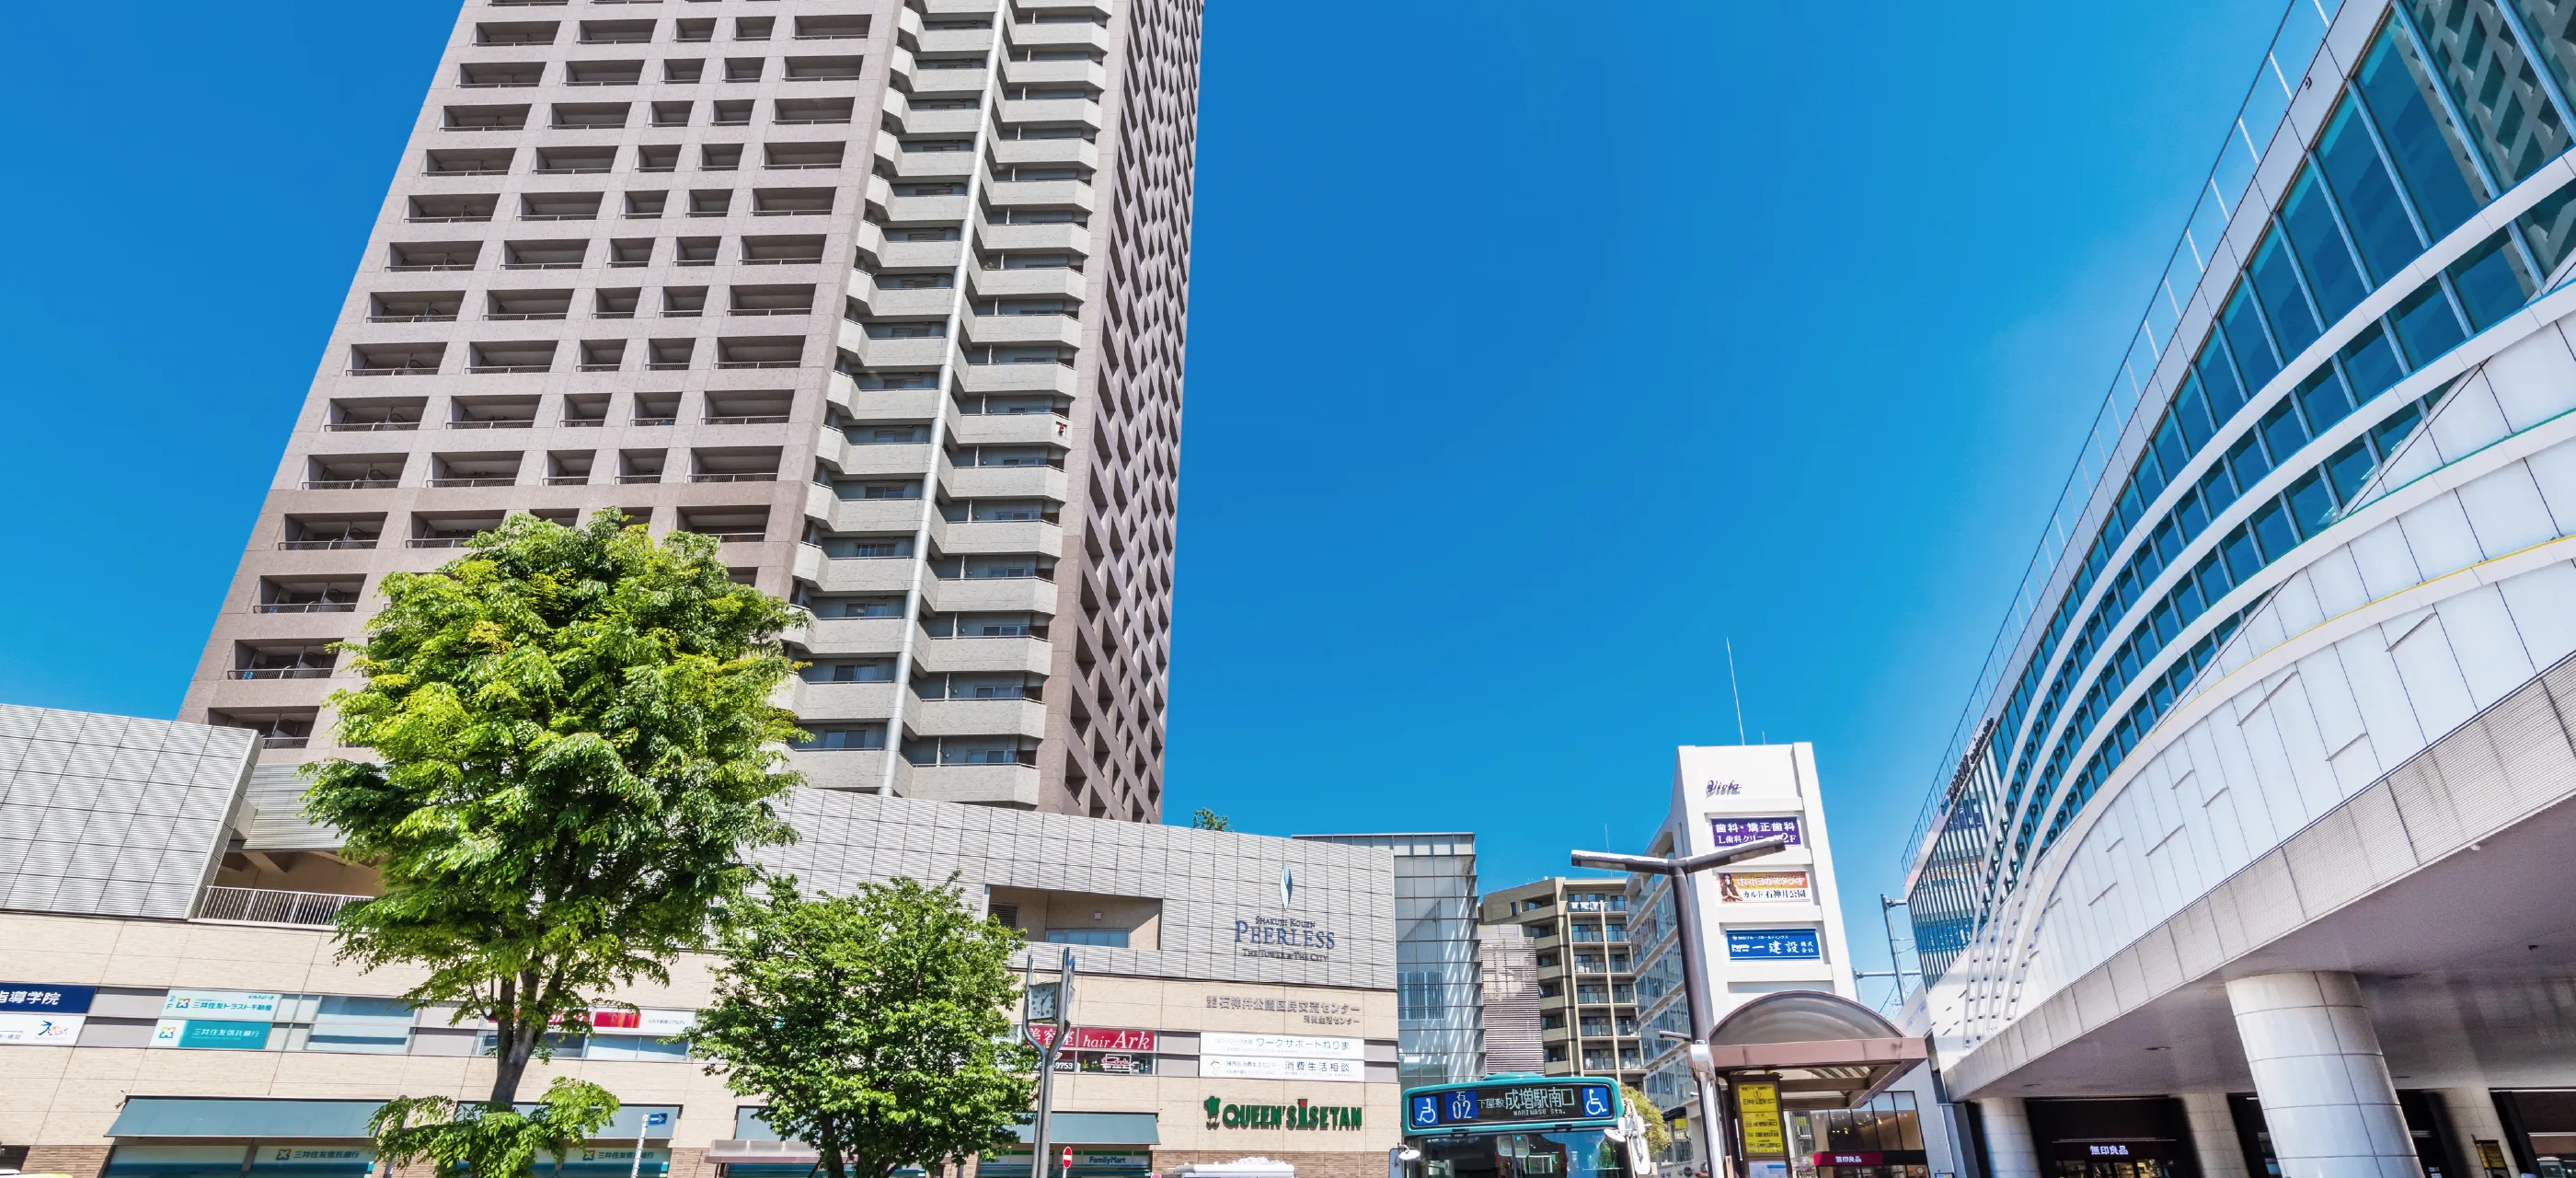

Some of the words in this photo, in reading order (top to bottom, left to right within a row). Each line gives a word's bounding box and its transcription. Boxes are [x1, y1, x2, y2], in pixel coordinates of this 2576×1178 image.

[1235, 919, 1336, 950] PEERLESS
[1083, 1034, 1110, 1048] hair
[1110, 1030, 1150, 1050] Ark
[1256, 1037, 1350, 1051] ワークサポートねりま
[1284, 1060, 1350, 1072] 消費生活相談
[1456, 1091, 1466, 1101] 石
[1504, 1087, 1575, 1110] 成増駅南口
[1222, 1103, 1297, 1128] QUEEN'S
[1296, 1098, 1363, 1129] ISETAN
[1453, 1101, 1472, 1119] 02
[2089, 1145, 2129, 1155] 無印良品
[1089, 1156, 1126, 1164] FamilyMart
